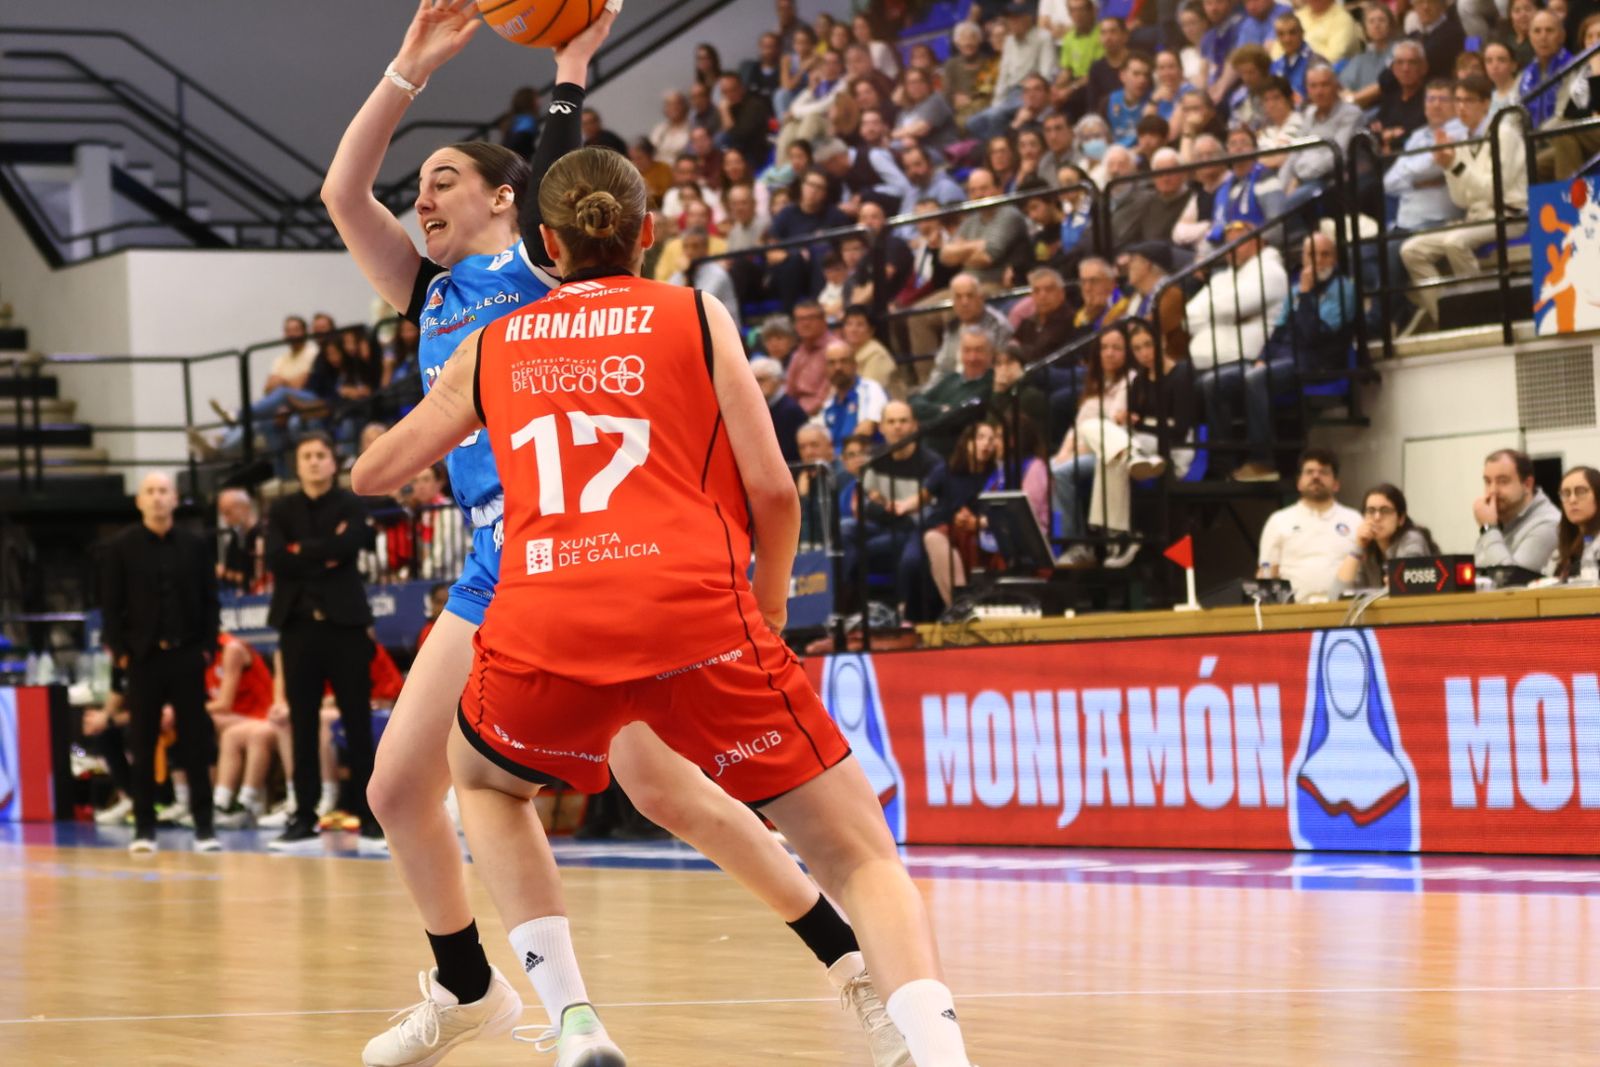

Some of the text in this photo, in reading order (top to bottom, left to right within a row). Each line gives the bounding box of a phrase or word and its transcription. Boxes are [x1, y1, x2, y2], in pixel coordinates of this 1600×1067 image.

[475, 290, 519, 311] LEÓN
[504, 306, 655, 342] HERNÁNDEZ
[512, 373, 597, 395] DE LUGO
[510, 411, 650, 517] 17
[559, 532, 621, 551] XUNTA
[558, 543, 661, 567] DE GALICIA
[1403, 568, 1437, 585] POSSE
[714, 730, 782, 777] galicia
[922, 655, 1286, 829] MONJAMÓN
